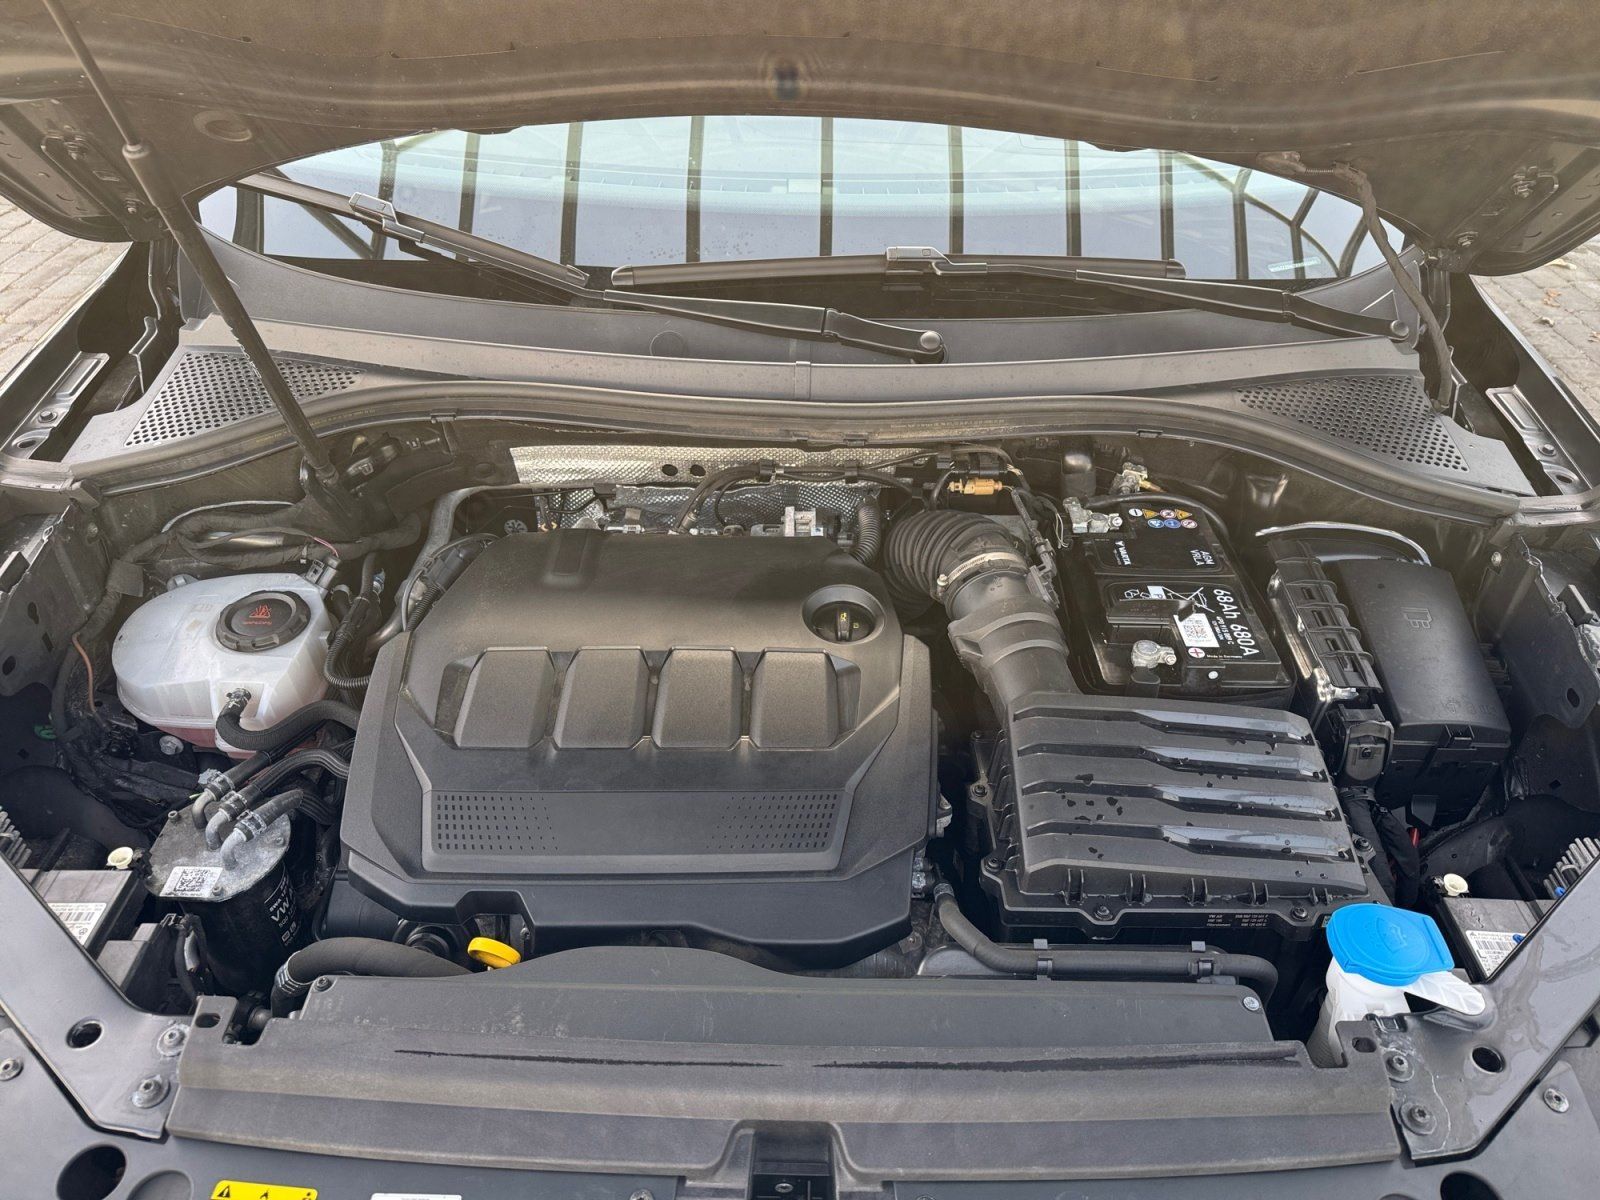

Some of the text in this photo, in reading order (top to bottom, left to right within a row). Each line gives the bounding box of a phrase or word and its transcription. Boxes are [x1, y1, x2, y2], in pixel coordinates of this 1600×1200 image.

[1190, 549, 1202, 566] VRLA
[1200, 550, 1215, 565] AGM
[1213, 588, 1241, 620] 68Ah
[1230, 624, 1259, 656] 680A
[271, 897, 289, 921] VW
